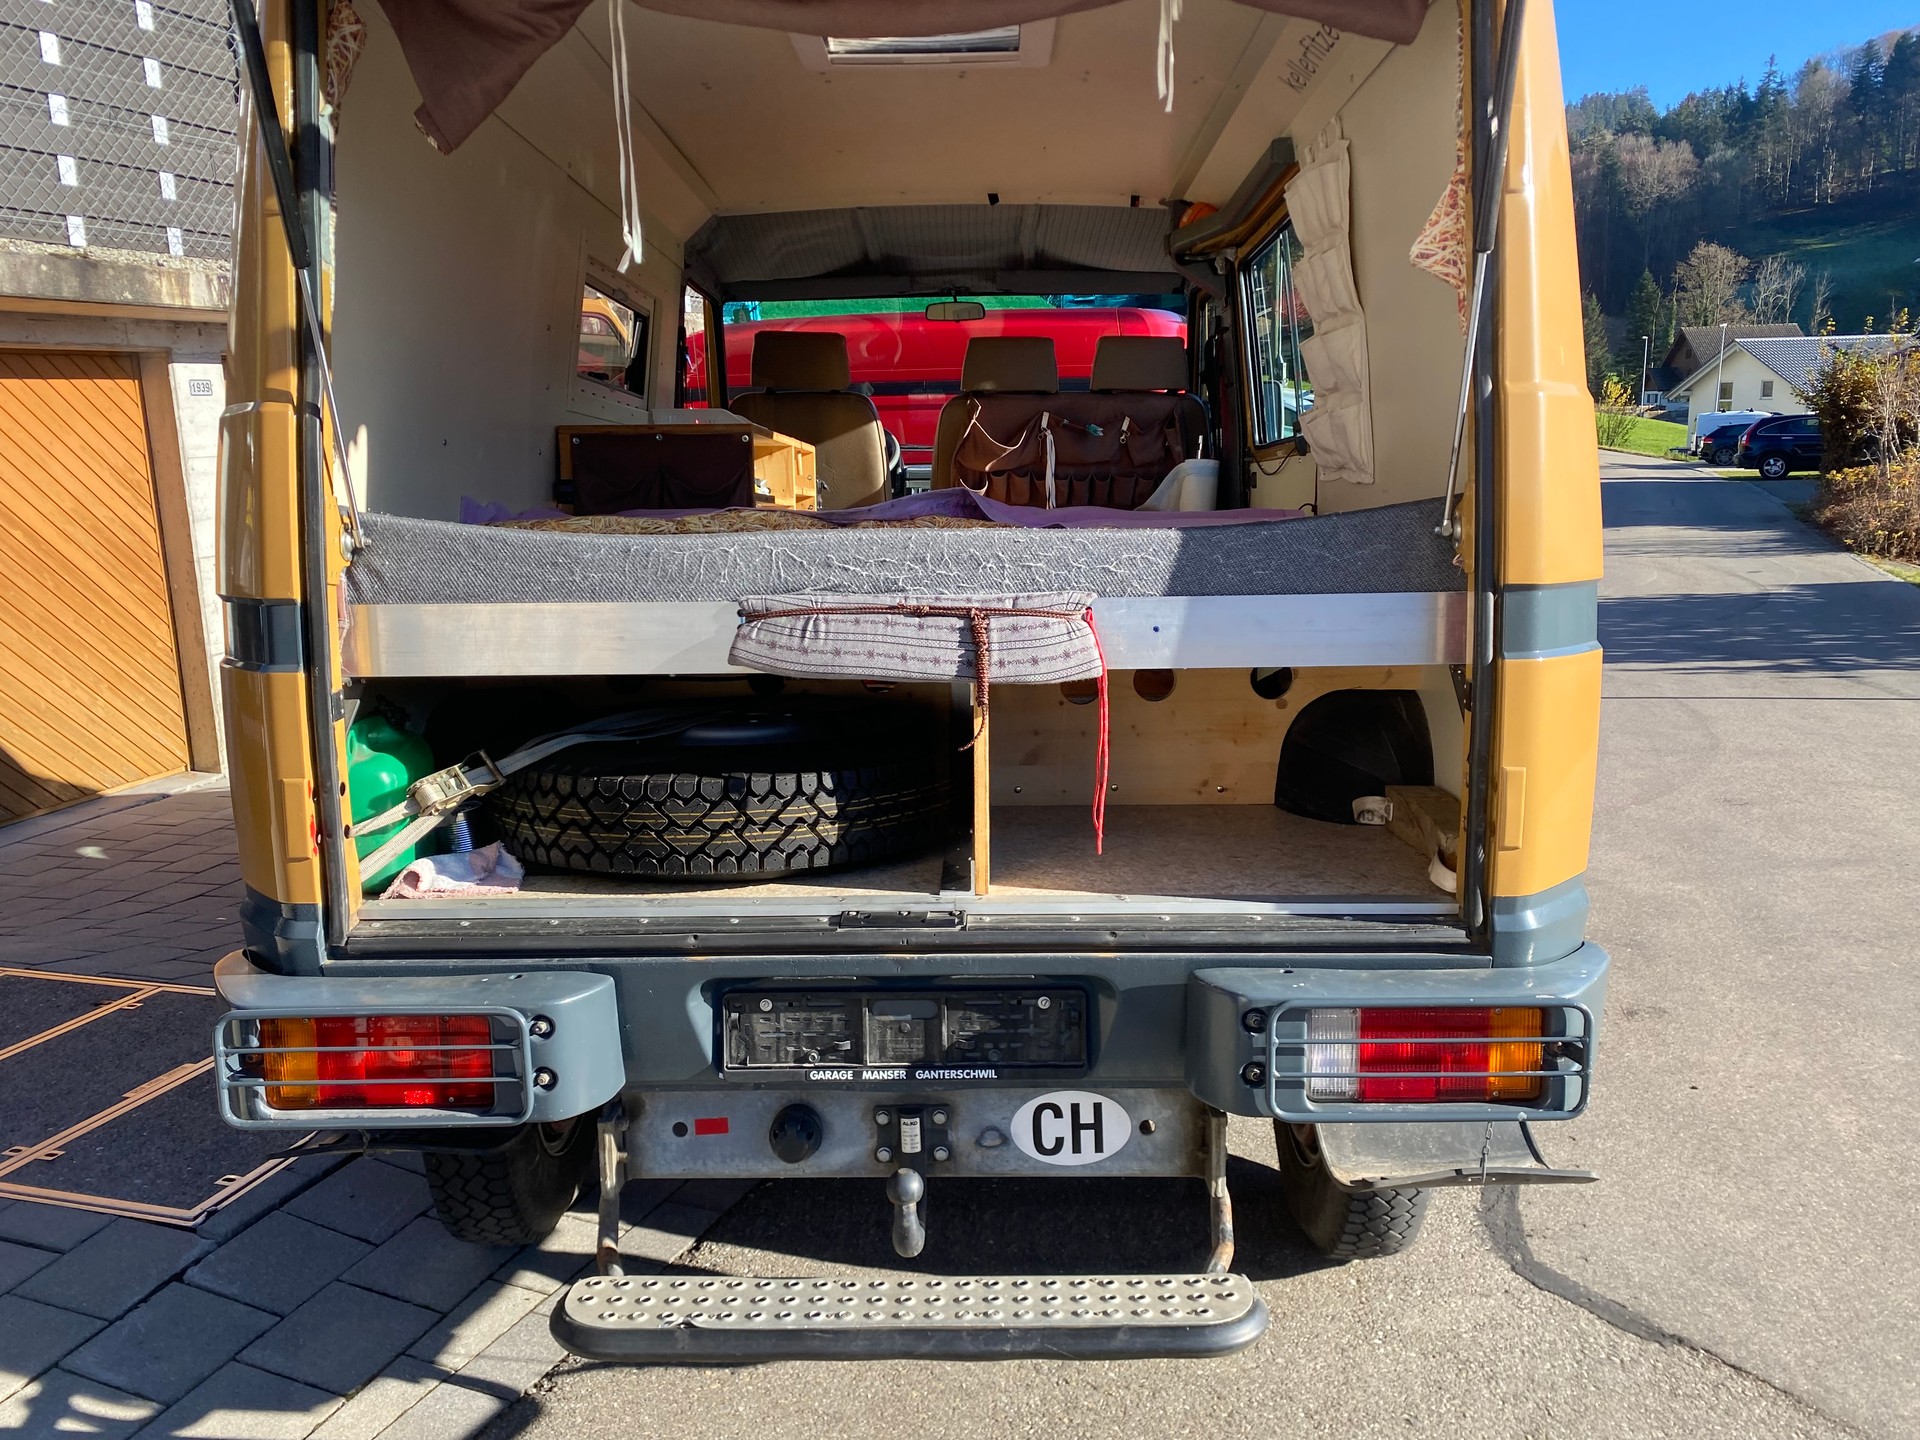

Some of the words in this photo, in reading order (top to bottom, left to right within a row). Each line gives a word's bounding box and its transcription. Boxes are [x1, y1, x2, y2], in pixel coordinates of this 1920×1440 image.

[192, 382, 210, 393] 1939
[809, 1070, 854, 1080] GARAGE
[862, 1070, 907, 1080] MANSER
[915, 1069, 998, 1079] GANTERSCHWIL
[1032, 1102, 1104, 1156] CH
